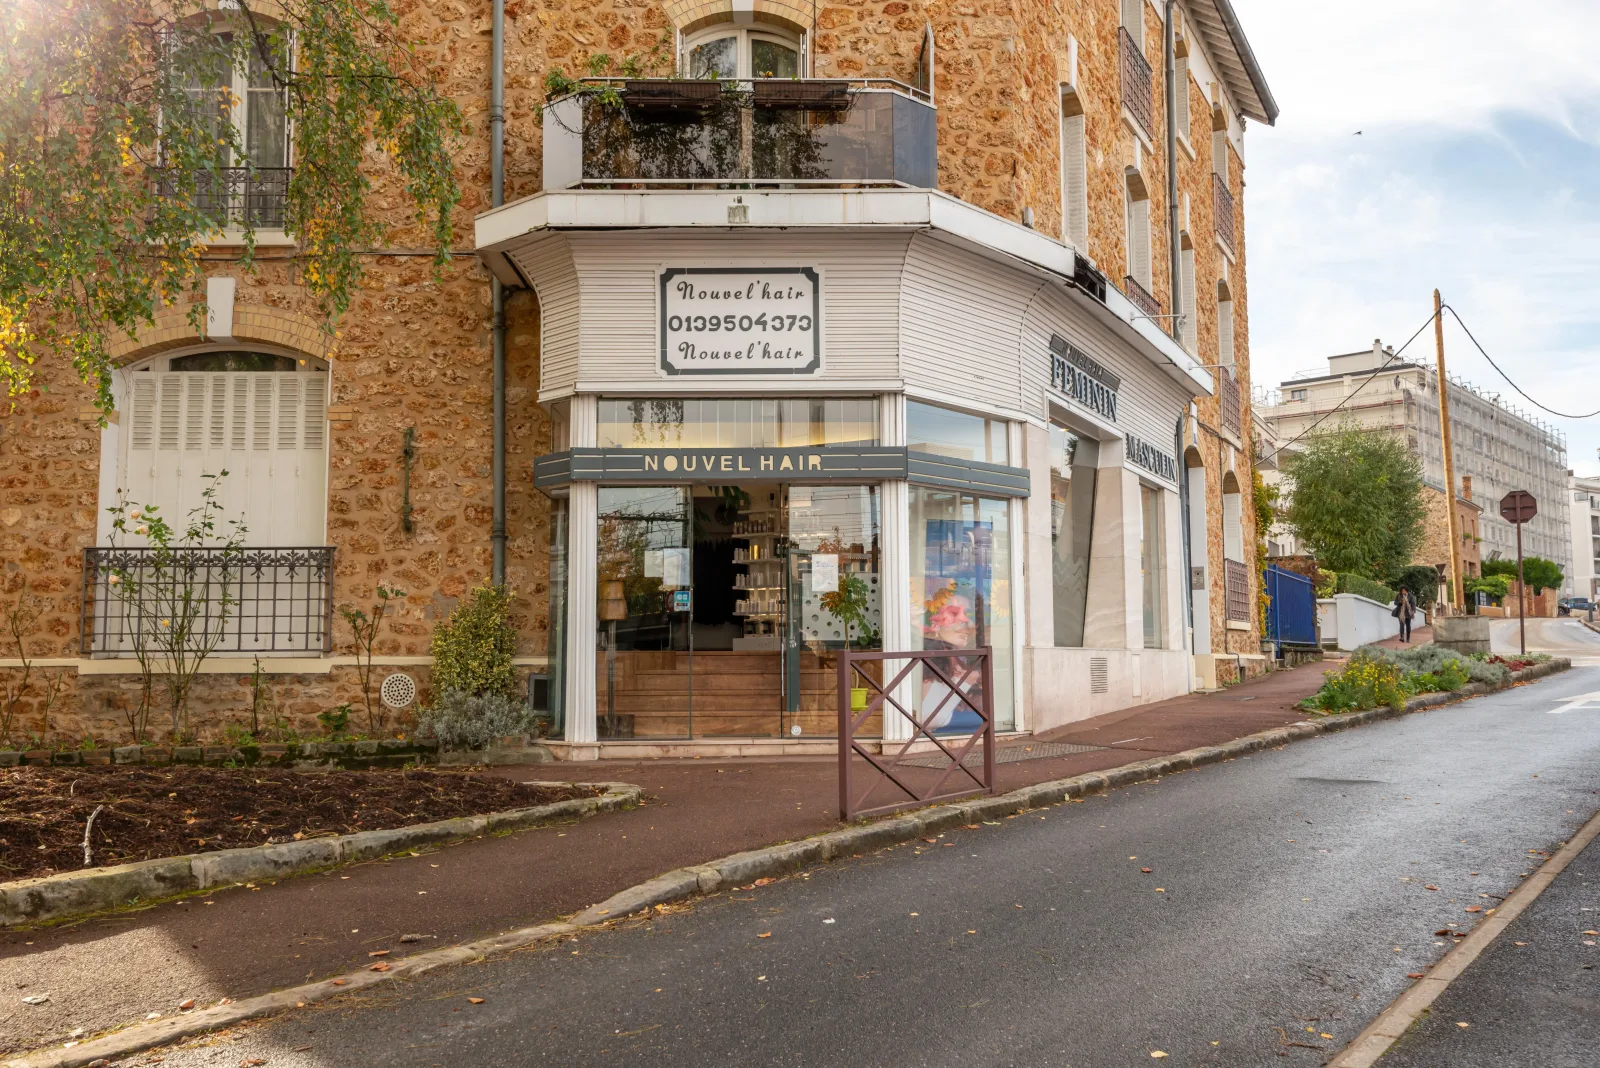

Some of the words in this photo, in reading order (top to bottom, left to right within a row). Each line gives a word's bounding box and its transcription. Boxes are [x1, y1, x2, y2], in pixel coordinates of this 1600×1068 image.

[677, 280, 804, 300] Nouvel'hair
[668, 312, 812, 332] 0139504373
[678, 340, 803, 360] Nouvel'hair
[1050, 353, 1117, 423] FEMININ
[644, 455, 751, 472] NOUVEL
[760, 455, 822, 471] HAIR
[1125, 432, 1176, 483] MASCULIN
